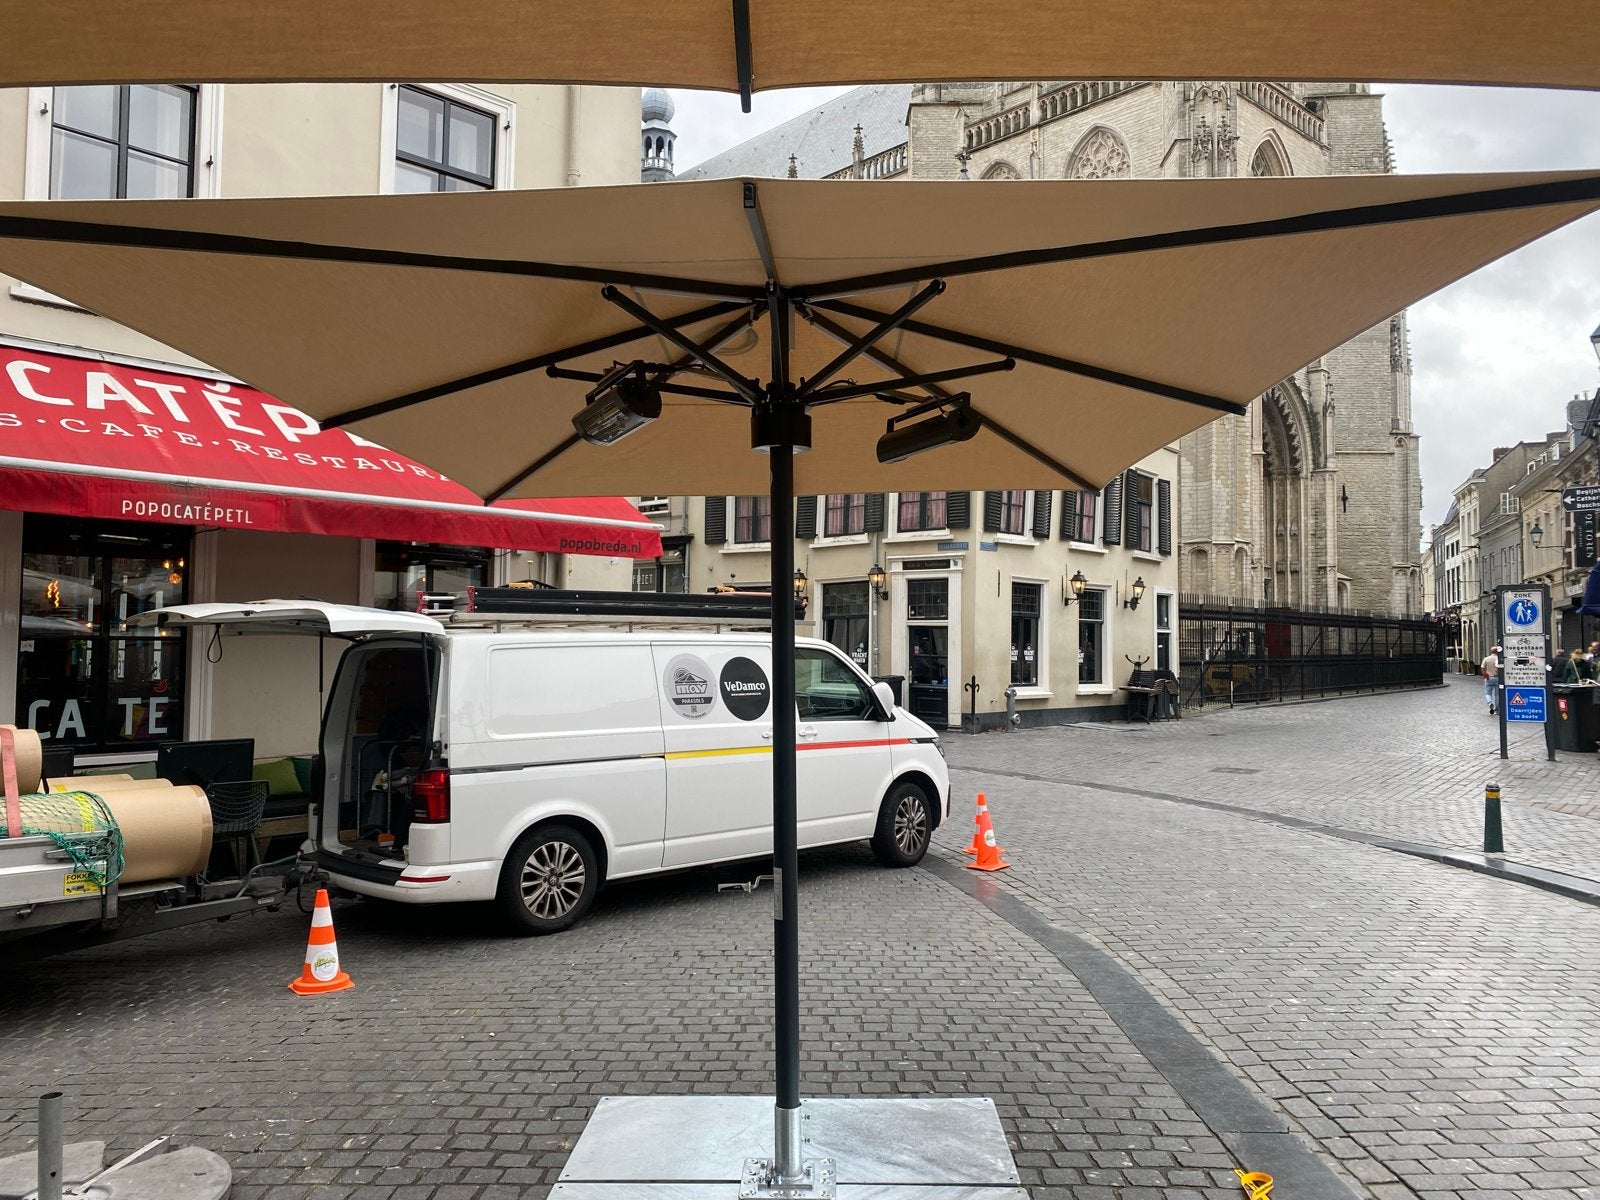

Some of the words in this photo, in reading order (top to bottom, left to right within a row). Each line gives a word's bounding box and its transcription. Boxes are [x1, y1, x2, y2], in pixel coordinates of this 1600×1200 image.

[227, 438, 451, 482] RESTAUR
[121, 500, 253, 525] POPOCATÉPETL
[559, 536, 642, 554] popobreda.nl
[1585, 530, 1594, 558] TOREN
[723, 681, 766, 692] VeDamco
